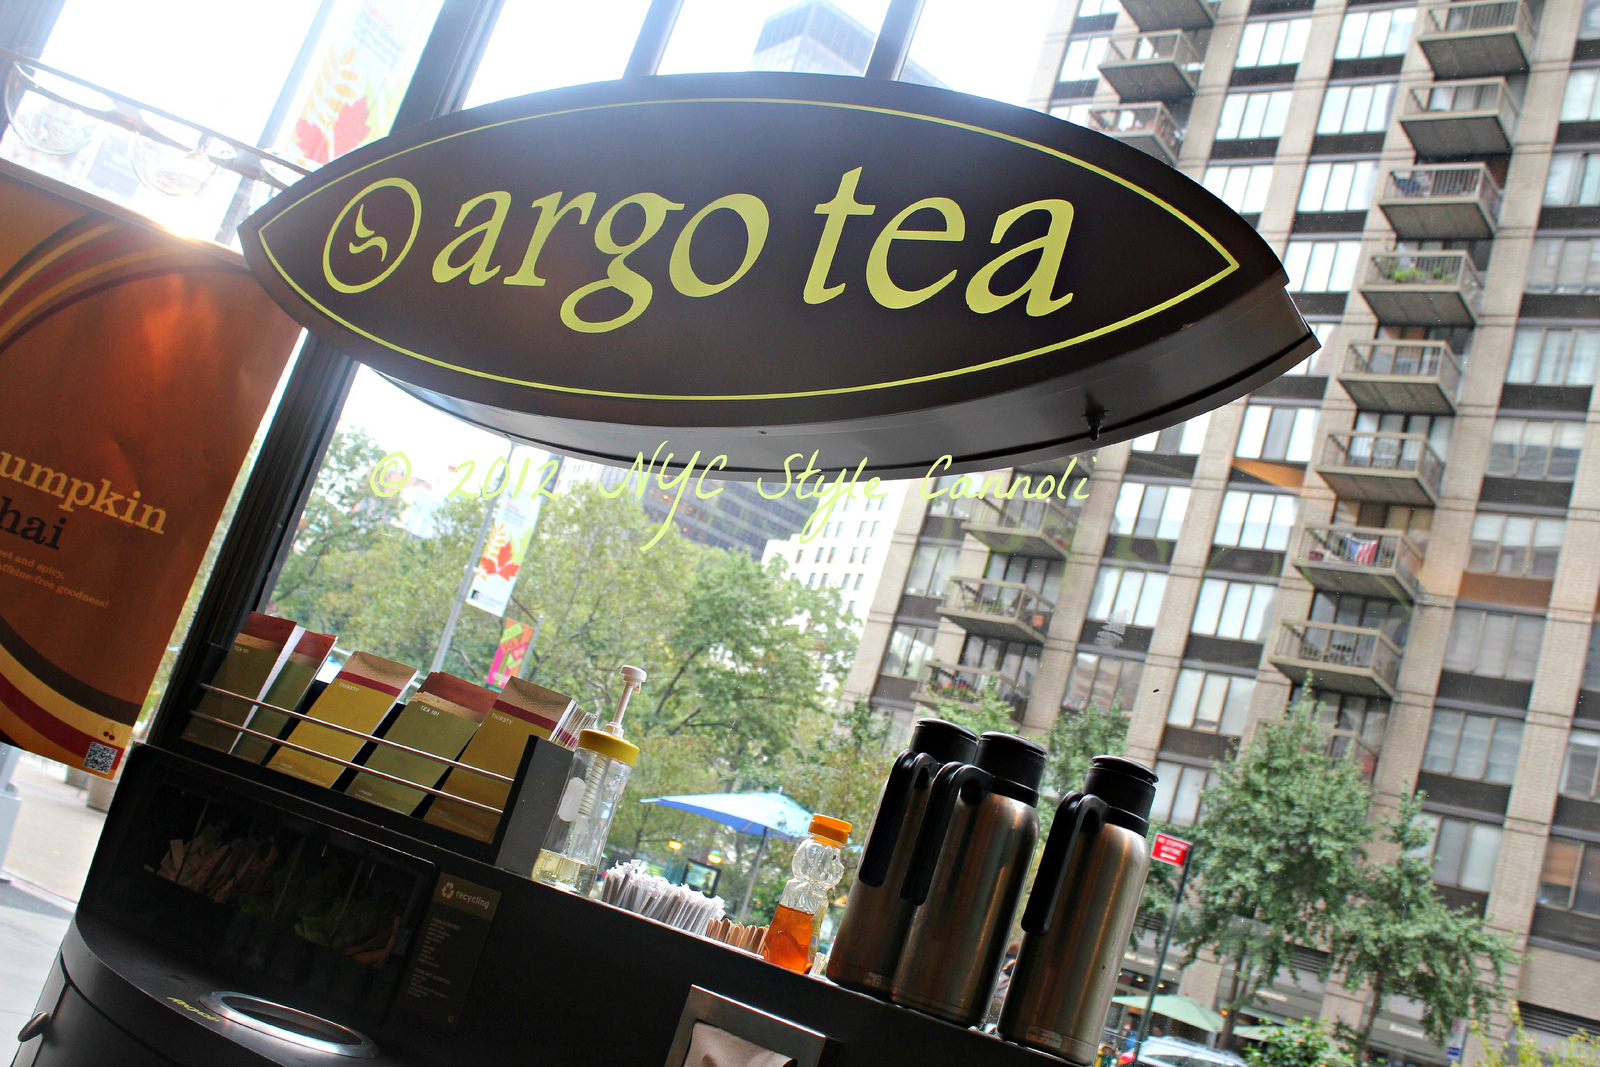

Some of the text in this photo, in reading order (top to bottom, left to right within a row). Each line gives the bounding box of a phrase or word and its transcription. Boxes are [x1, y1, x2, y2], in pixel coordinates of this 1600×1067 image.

[432, 166, 1075, 334] argo tea
[14, 556, 36, 568] and
[36, 564, 65, 580] spicy,
[56, 585, 109, 609] goodness!
[339, 682, 360, 692] THIRSTY
[420, 705, 431, 713] TEA
[491, 712, 514, 725] THIRSTY
[455, 890, 490, 910] recycling
